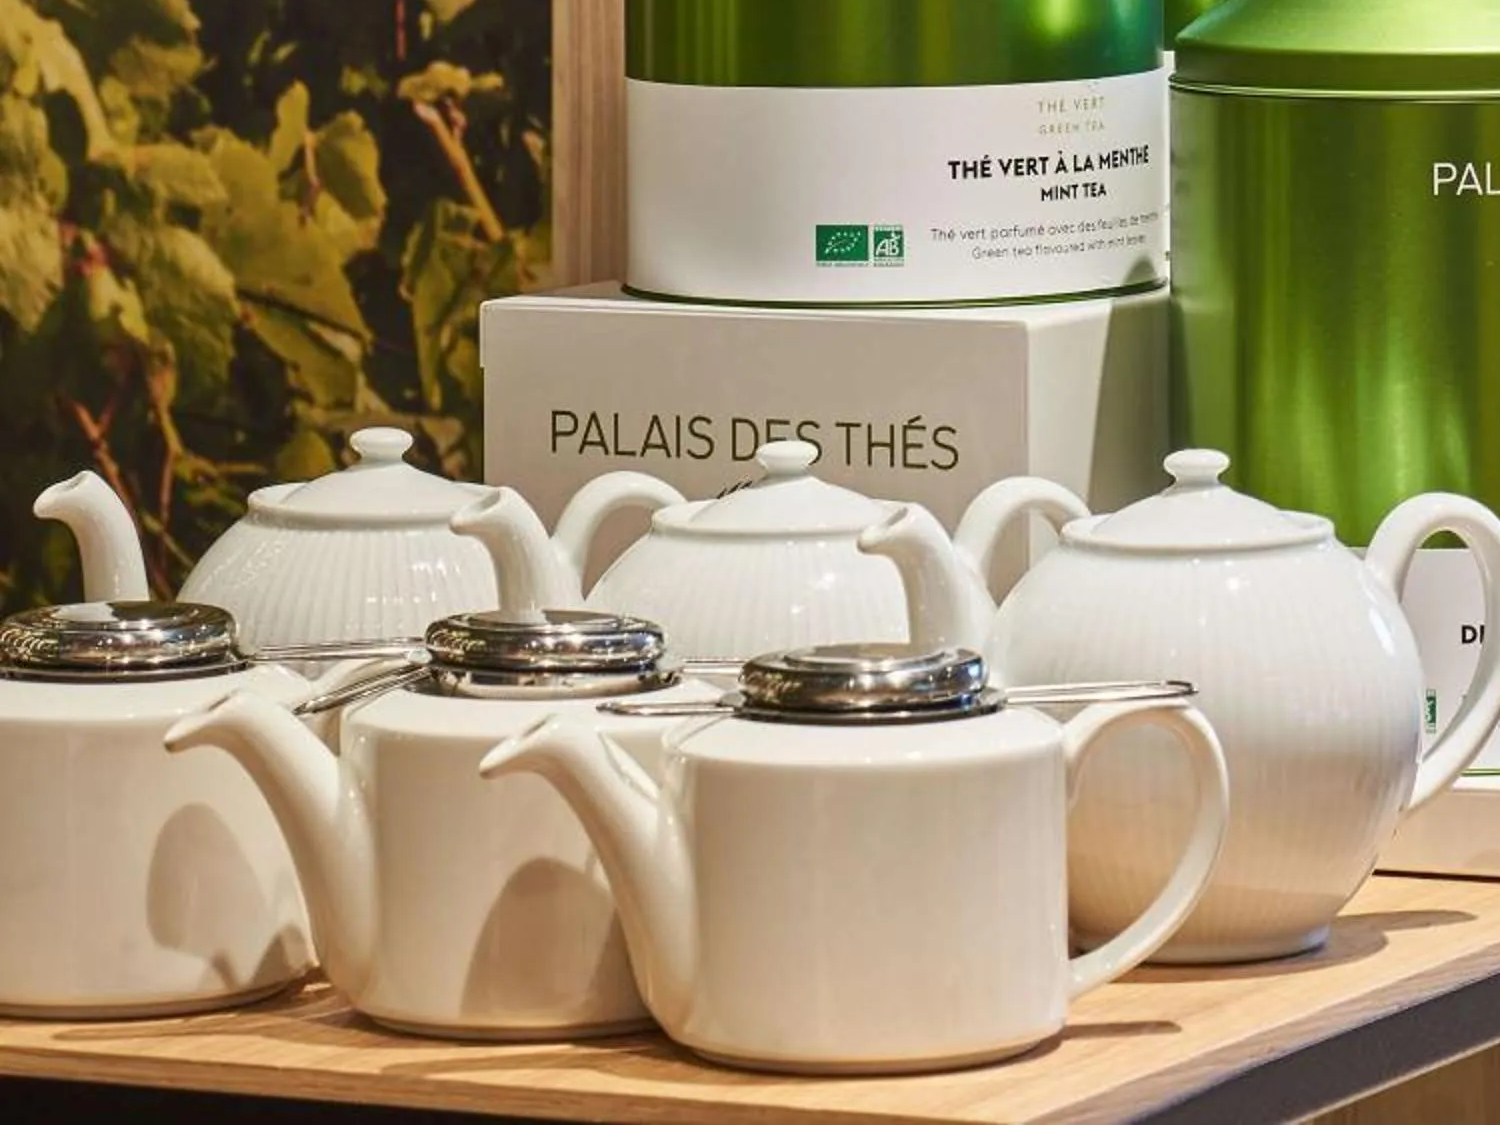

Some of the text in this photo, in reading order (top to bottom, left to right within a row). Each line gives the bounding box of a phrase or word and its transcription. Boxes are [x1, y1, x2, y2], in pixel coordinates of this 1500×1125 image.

[947, 144, 1151, 181] THÉ VERT À LA MENTHE
[1040, 181, 1108, 203] MINT TEA
[959, 226, 986, 241] vert
[990, 224, 1046, 245] parfumé
[971, 244, 1009, 261] Green
[550, 409, 960, 471] PALAIS DES THÉS
